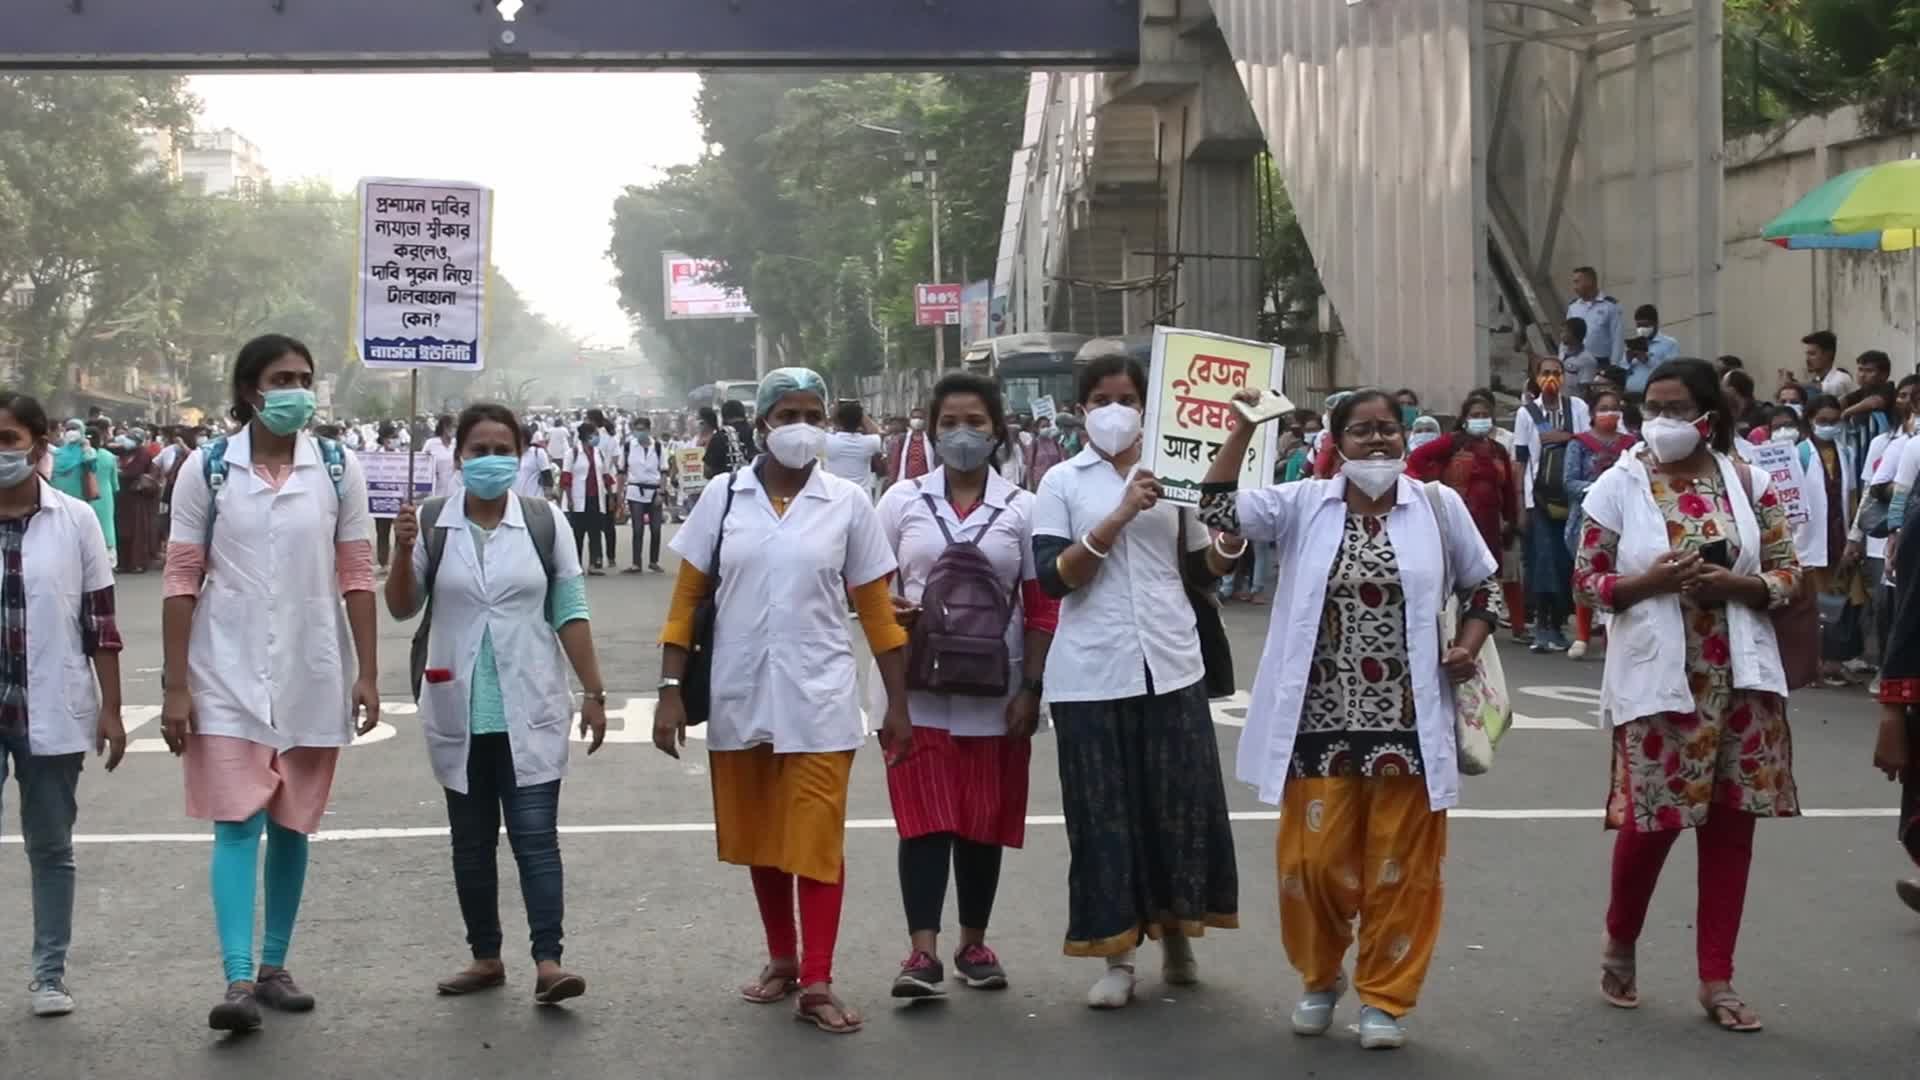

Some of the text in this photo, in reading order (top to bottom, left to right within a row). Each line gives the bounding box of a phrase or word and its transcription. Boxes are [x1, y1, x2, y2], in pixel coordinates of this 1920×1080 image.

[376, 196, 471, 218] প্রশাসন দাবির
[426, 217, 471, 240] স্বীকার
[371, 261, 400, 281] দাবি
[442, 264, 473, 286] নিয়ে
[387, 285, 457, 305] টালবাহানা
[402, 312, 441, 329] কেন?
[370, 342, 472, 361] নার্সেস ইউনিটি
[1187, 353, 1251, 388] বেতন
[1163, 434, 1203, 464] আর
